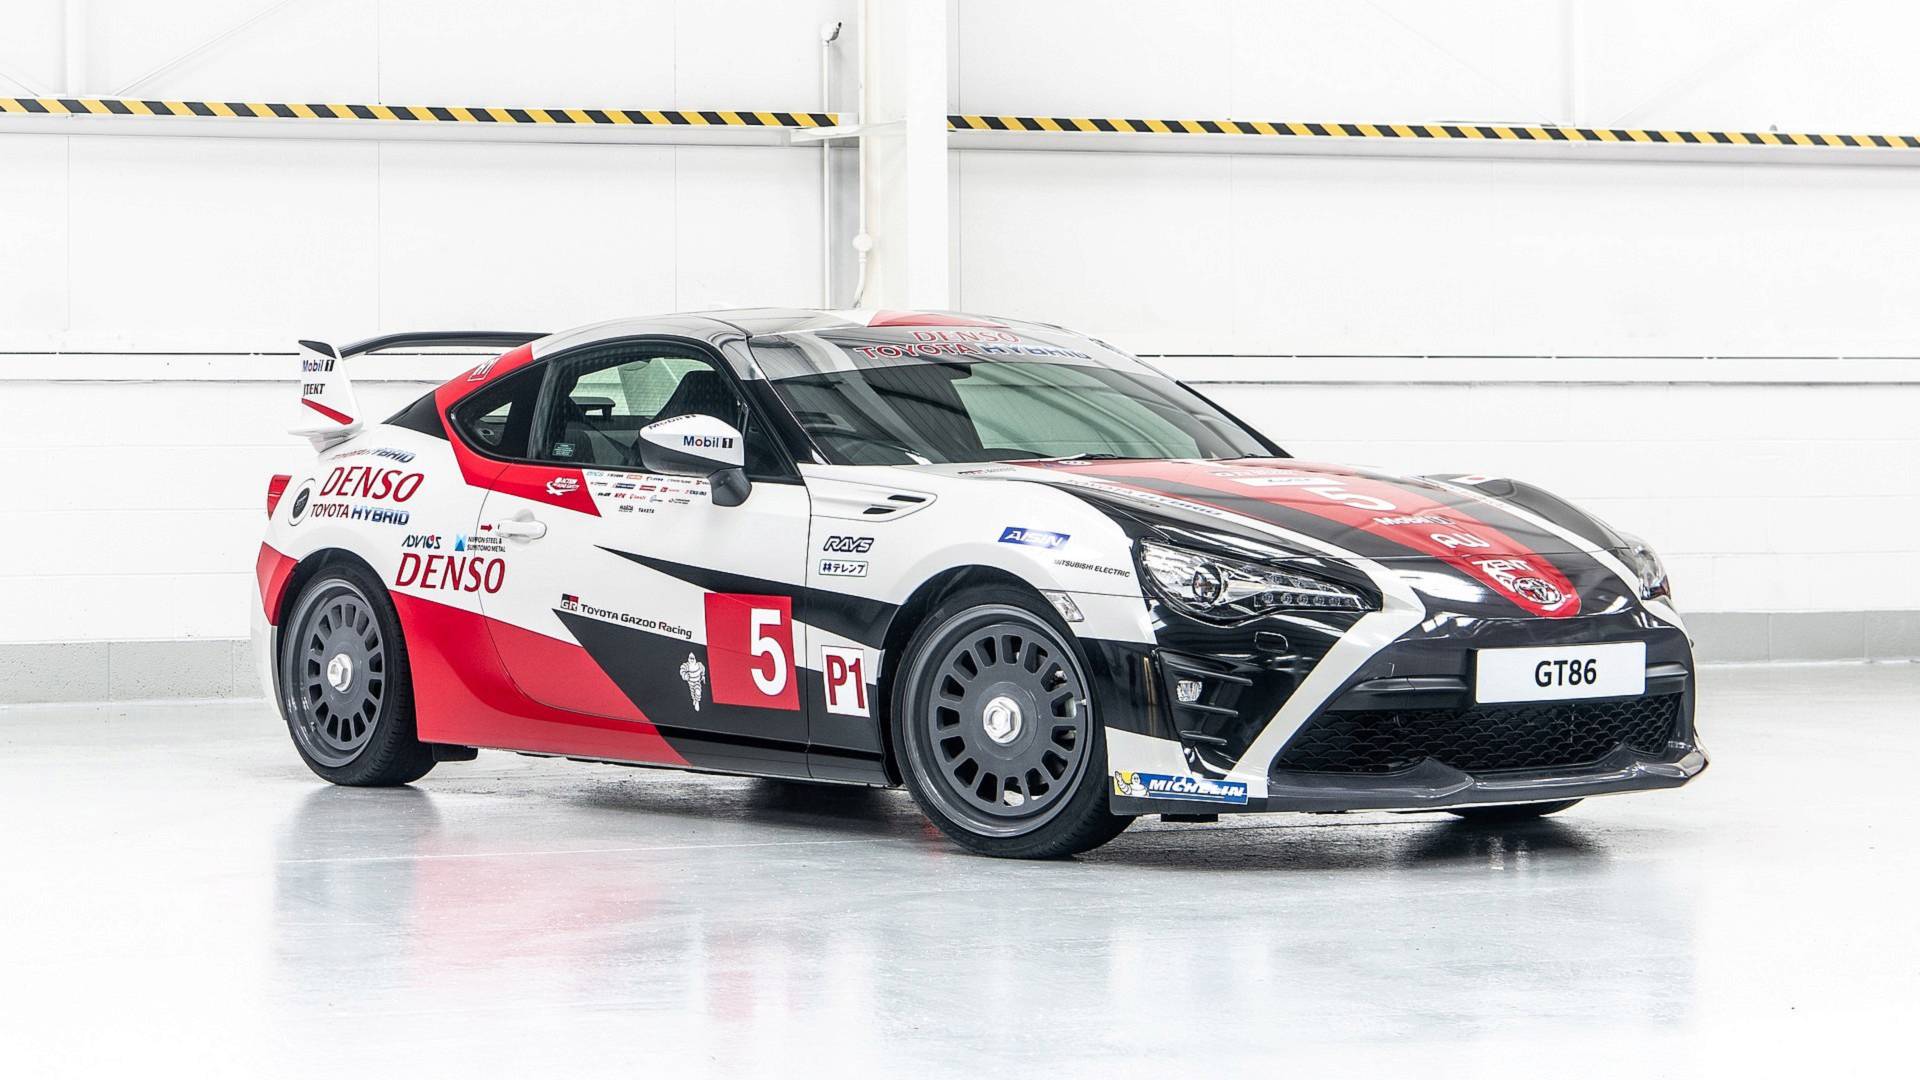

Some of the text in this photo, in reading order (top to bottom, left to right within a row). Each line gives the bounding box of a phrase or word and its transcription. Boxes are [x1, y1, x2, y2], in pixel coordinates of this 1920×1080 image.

[911, 330, 1022, 344] DENSO
[854, 343, 1093, 361] TOYOTA HYBRID
[303, 360, 324, 372] Mobil
[303, 384, 325, 397] JTEKT
[683, 435, 734, 449] Mobil 1
[319, 466, 425, 503] DENSO
[1301, 487, 1397, 511] 5
[311, 503, 410, 526] TOYOTA HYBRID
[1372, 515, 1426, 526] Mobil
[468, 536, 485, 544] NIPPON
[485, 537, 498, 545] STEEL
[491, 545, 506, 553] METAL
[823, 535, 874, 553] RAYS
[396, 553, 505, 594] DENSO
[1094, 565, 1131, 578] ELECTRIC
[1471, 559, 1534, 573] ZENT
[562, 600, 692, 640] GR TOYOTA GAZOO Racing
[749, 607, 788, 697] 5
[826, 653, 866, 710] P1
[1535, 658, 1598, 688] GT86
